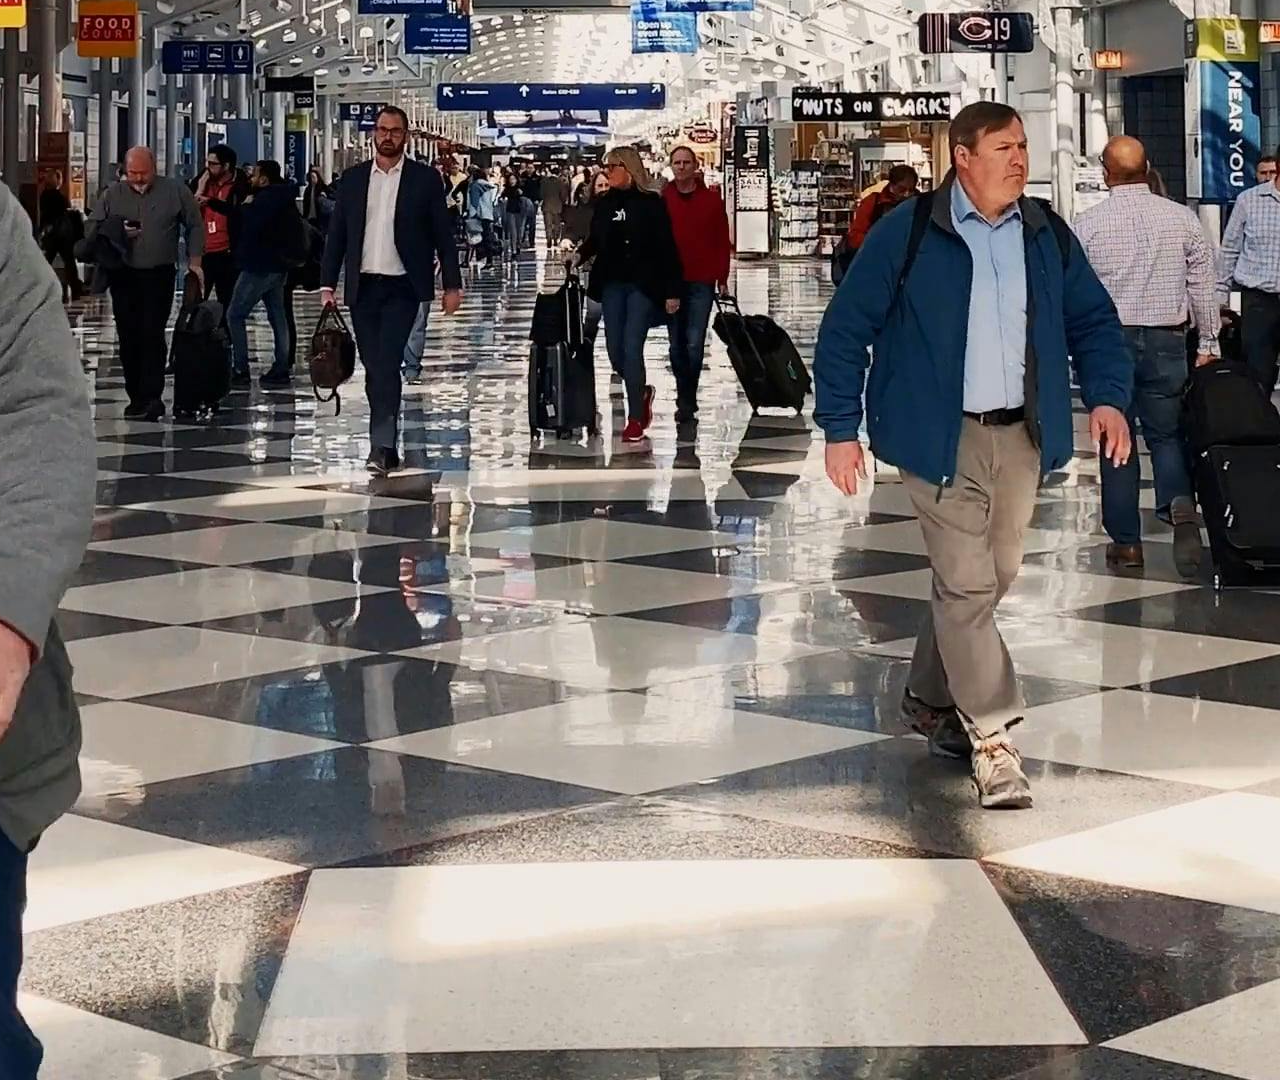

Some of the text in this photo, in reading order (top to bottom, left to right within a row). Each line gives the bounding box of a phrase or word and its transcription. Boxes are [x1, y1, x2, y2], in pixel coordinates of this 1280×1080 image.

[83, 17, 131, 29] FOOD
[81, 29, 134, 39] COURT
[296, 96, 312, 104] C20
[853, 100, 873, 113] ON
[1228, 70, 1244, 188] NEAR YOU
[288, 134, 296, 154] YOU
